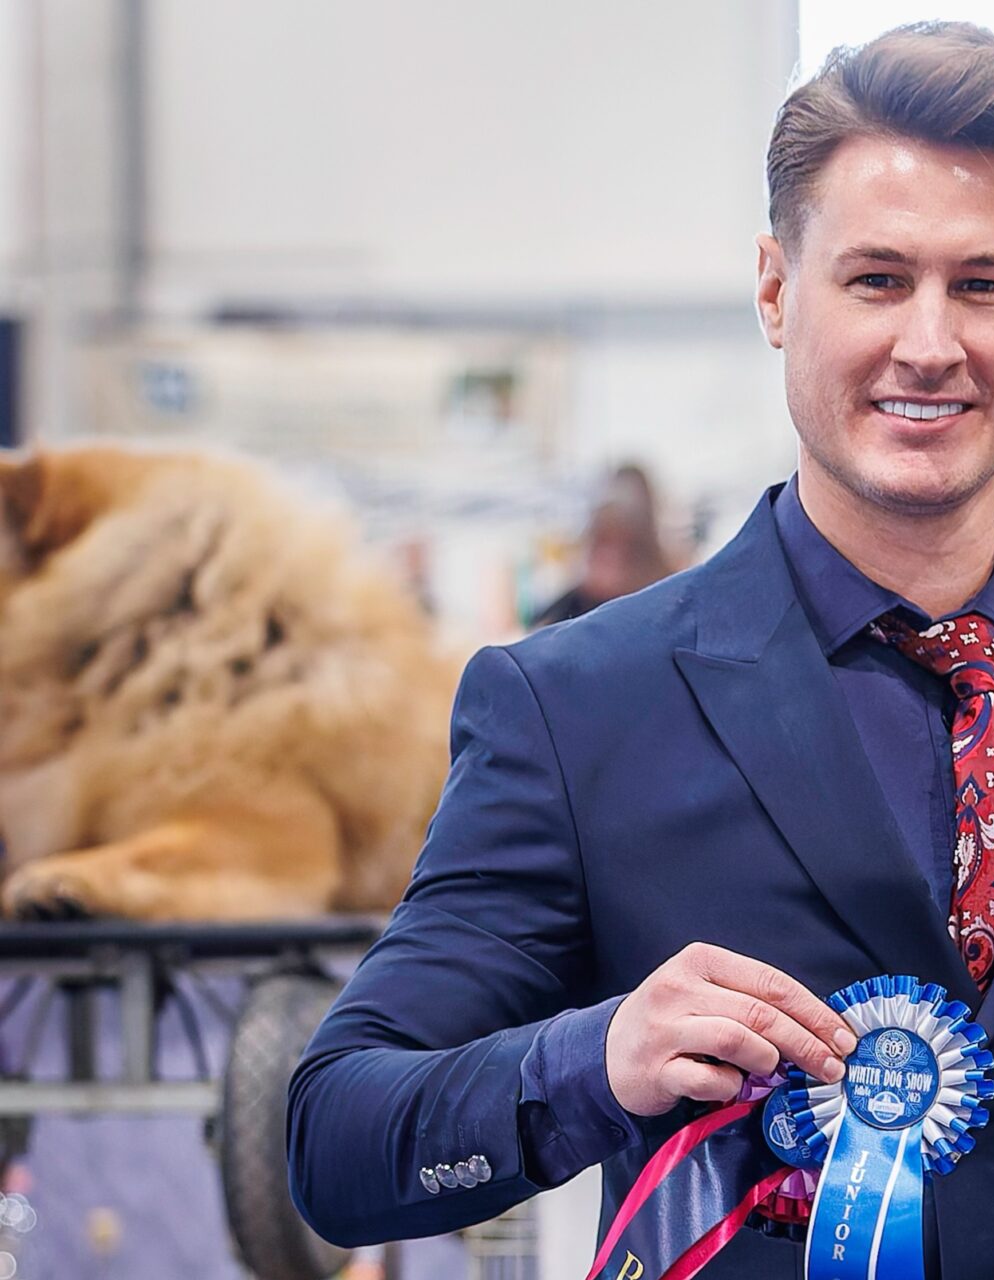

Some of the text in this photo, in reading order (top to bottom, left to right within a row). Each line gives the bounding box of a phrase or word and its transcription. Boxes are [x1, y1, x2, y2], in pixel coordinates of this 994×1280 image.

[849, 1065, 933, 1092] WINTER DOG SHOW
[832, 1150, 869, 1261] JUNIOR
